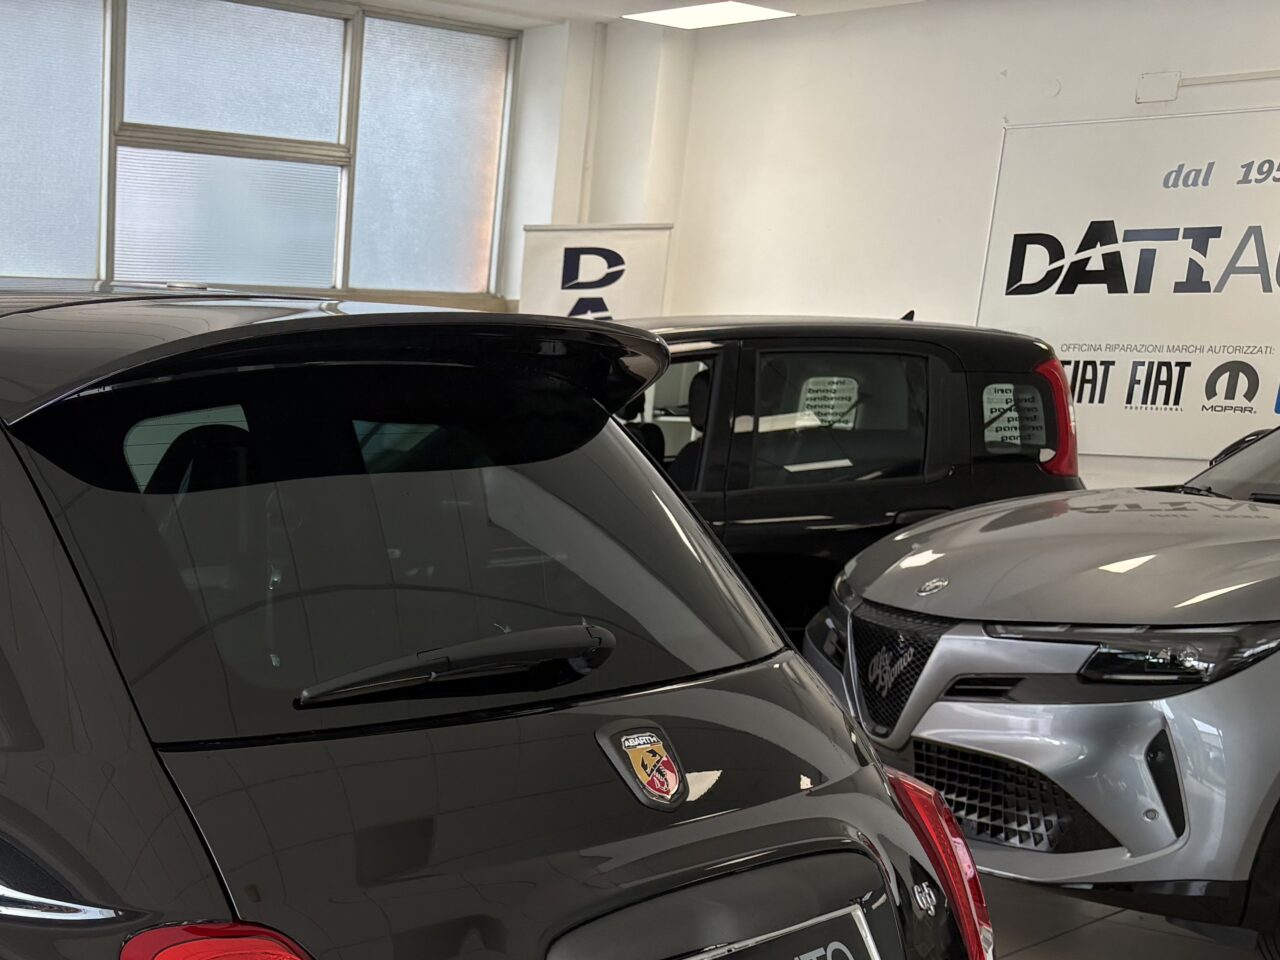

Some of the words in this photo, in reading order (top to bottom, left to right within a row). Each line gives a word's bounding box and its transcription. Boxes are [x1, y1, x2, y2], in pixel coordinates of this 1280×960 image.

[1163, 161, 1216, 189] dal
[1060, 343, 1103, 353] OFFICINA
[1104, 343, 1164, 354] RIPARAZIONI
[1166, 344, 1205, 354] MARCHI
[1125, 361, 1192, 406] FIAT
[1124, 405, 1184, 413] PROFESSIONAL
[624, 735, 658, 747] ABARTH
